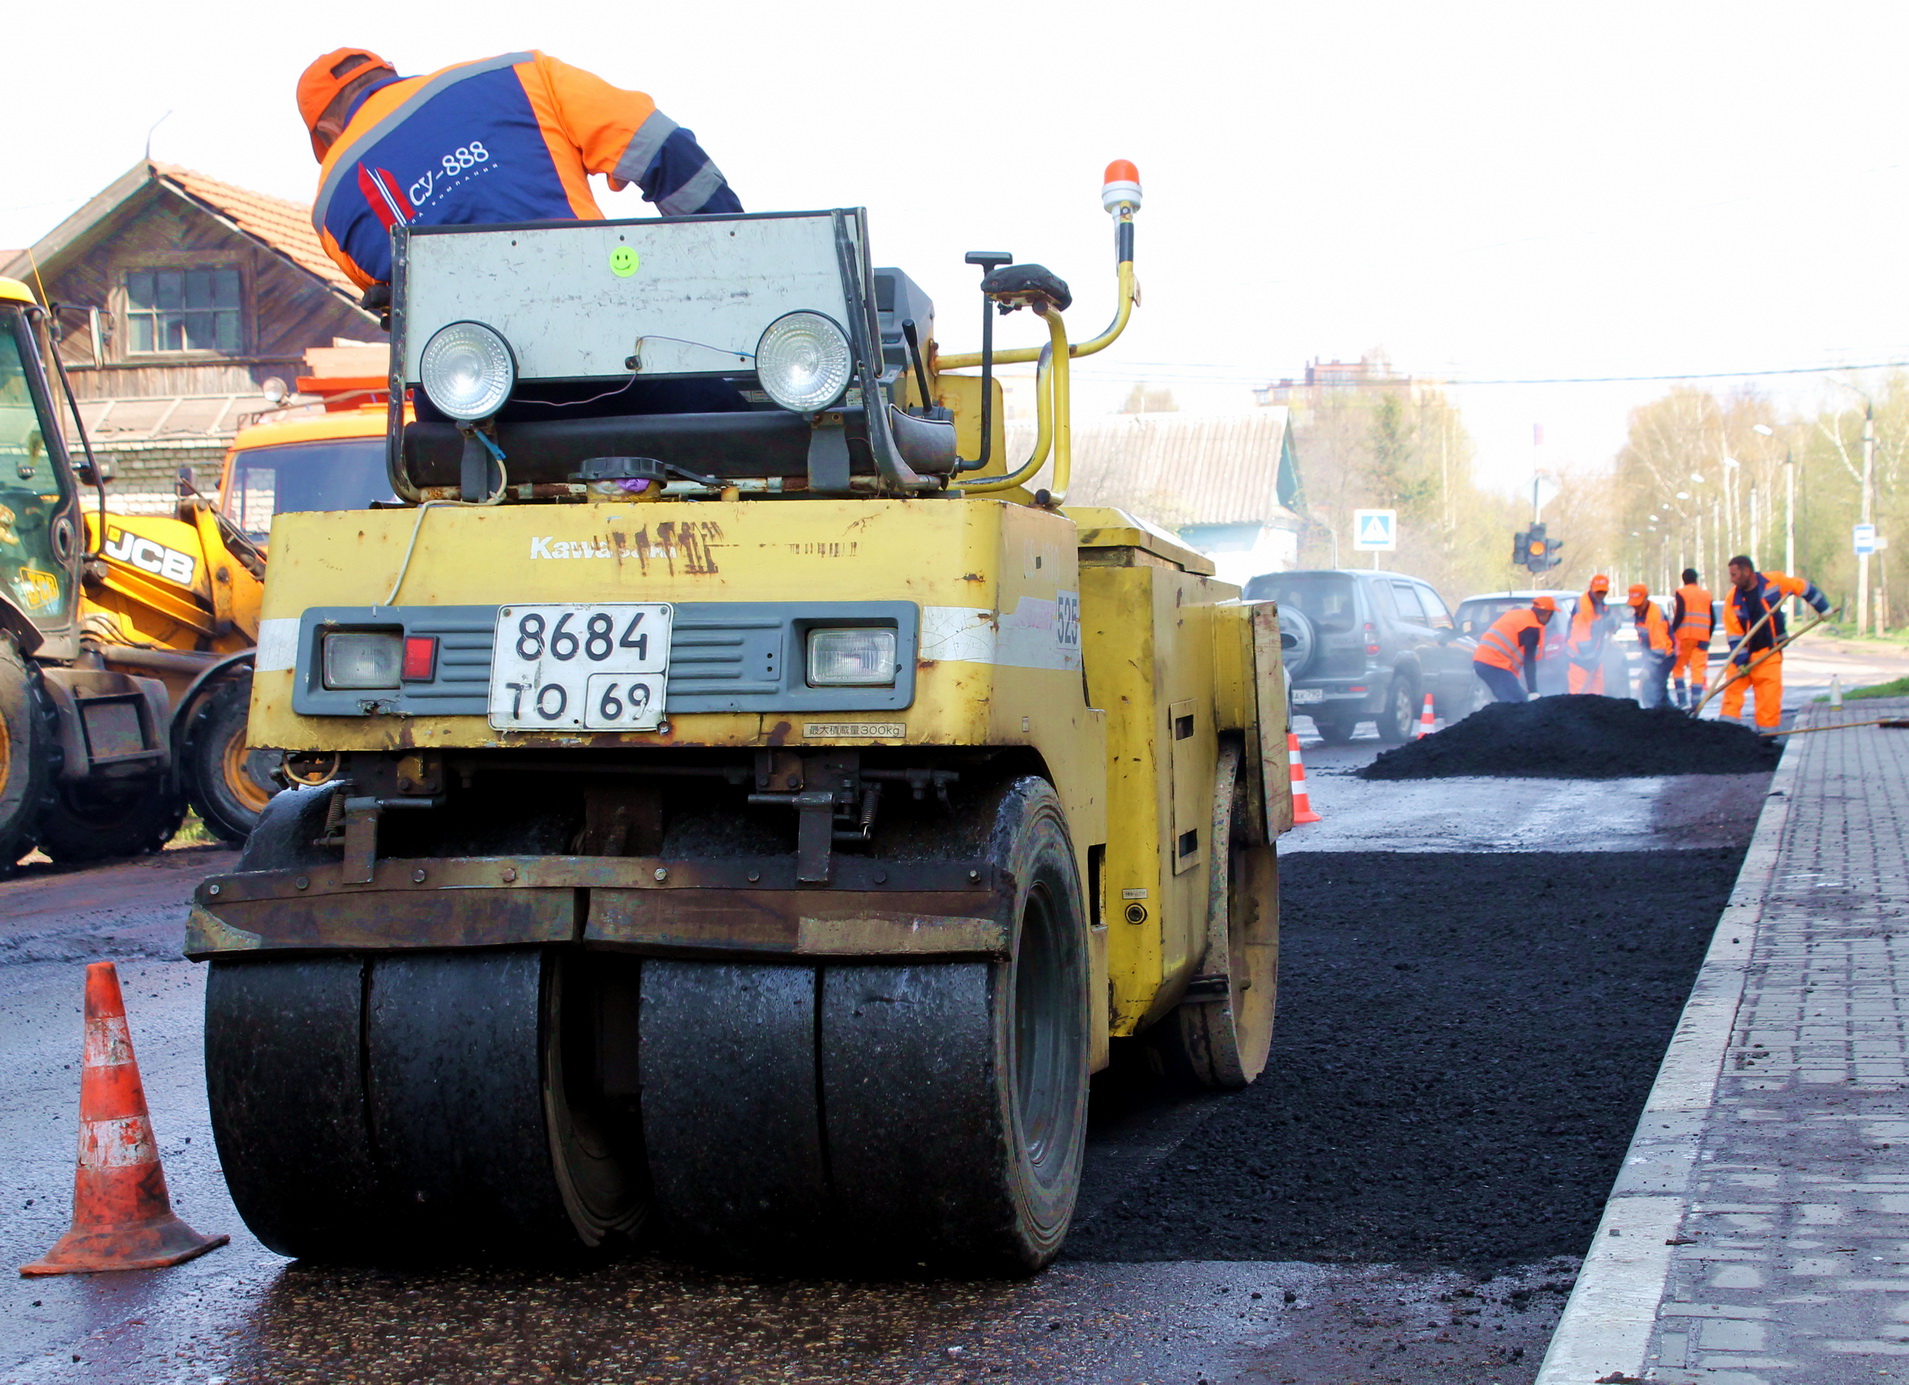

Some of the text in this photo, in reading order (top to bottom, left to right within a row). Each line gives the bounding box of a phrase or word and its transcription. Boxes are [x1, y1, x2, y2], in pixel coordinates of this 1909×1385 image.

[409, 141, 489, 206] СУ-888
[105, 532, 194, 584] JCB
[26, 571, 58, 605] JCB
[516, 612, 648, 661] 8684
[1057, 596, 1078, 645] 525
[600, 682, 650, 721] 69
